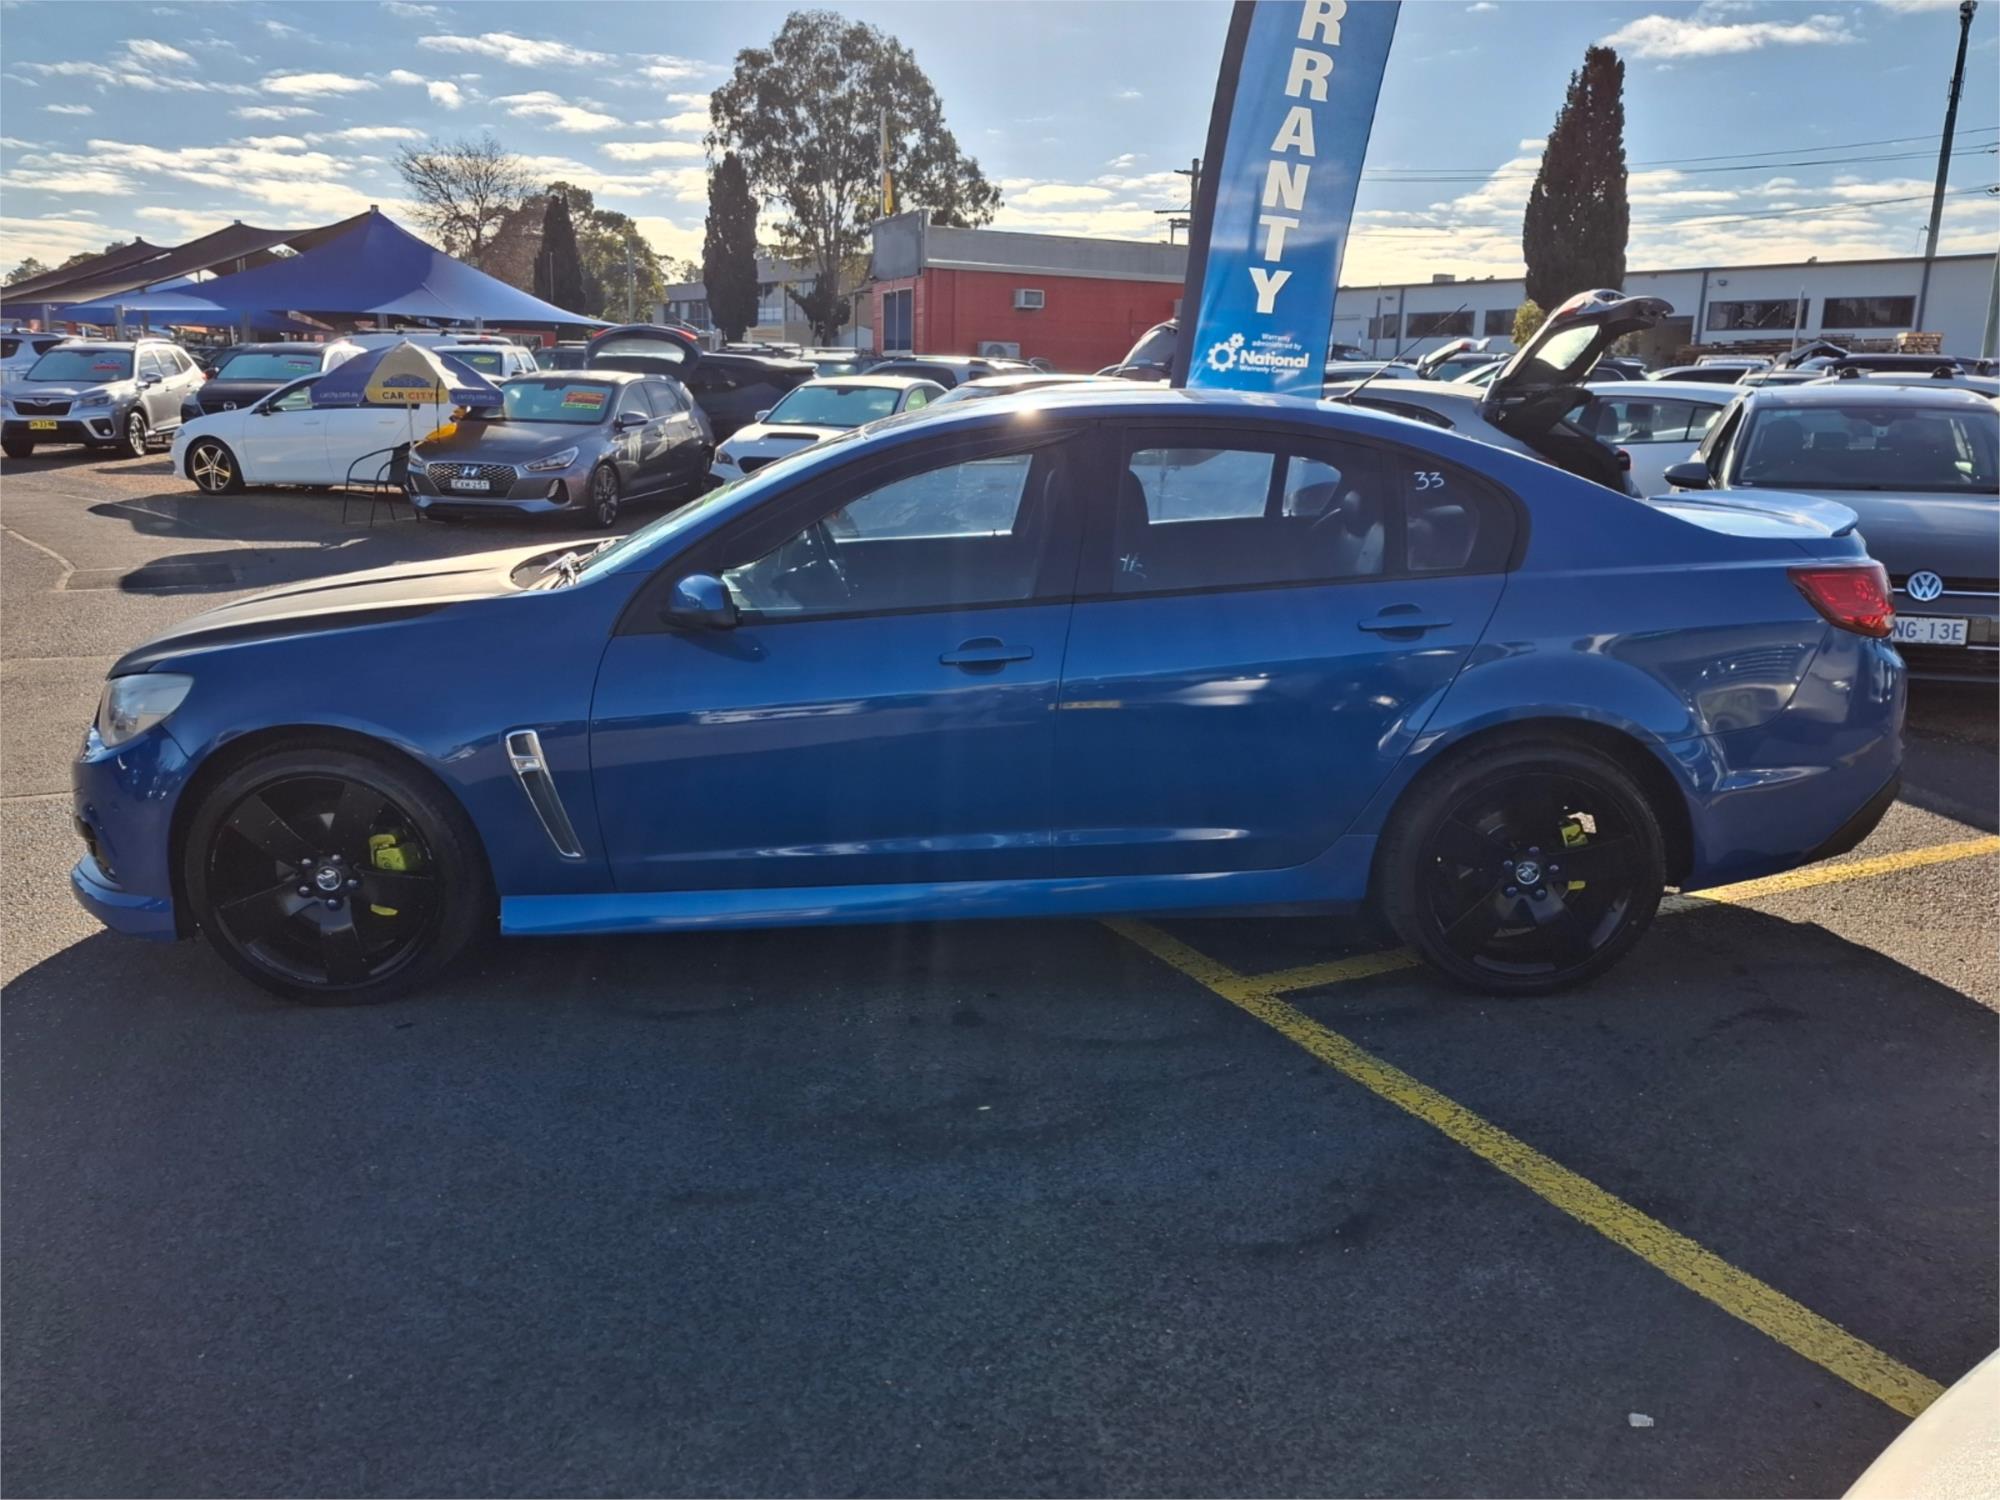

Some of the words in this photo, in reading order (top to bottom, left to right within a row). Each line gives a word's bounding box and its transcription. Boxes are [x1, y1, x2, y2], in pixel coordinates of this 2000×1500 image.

[1239, 349, 1310, 368] National
[1239, 365, 1270, 375] Warranty
[382, 391, 405, 400] CAR
[407, 391, 434, 400] CITY
[1414, 471, 1445, 490] 33
